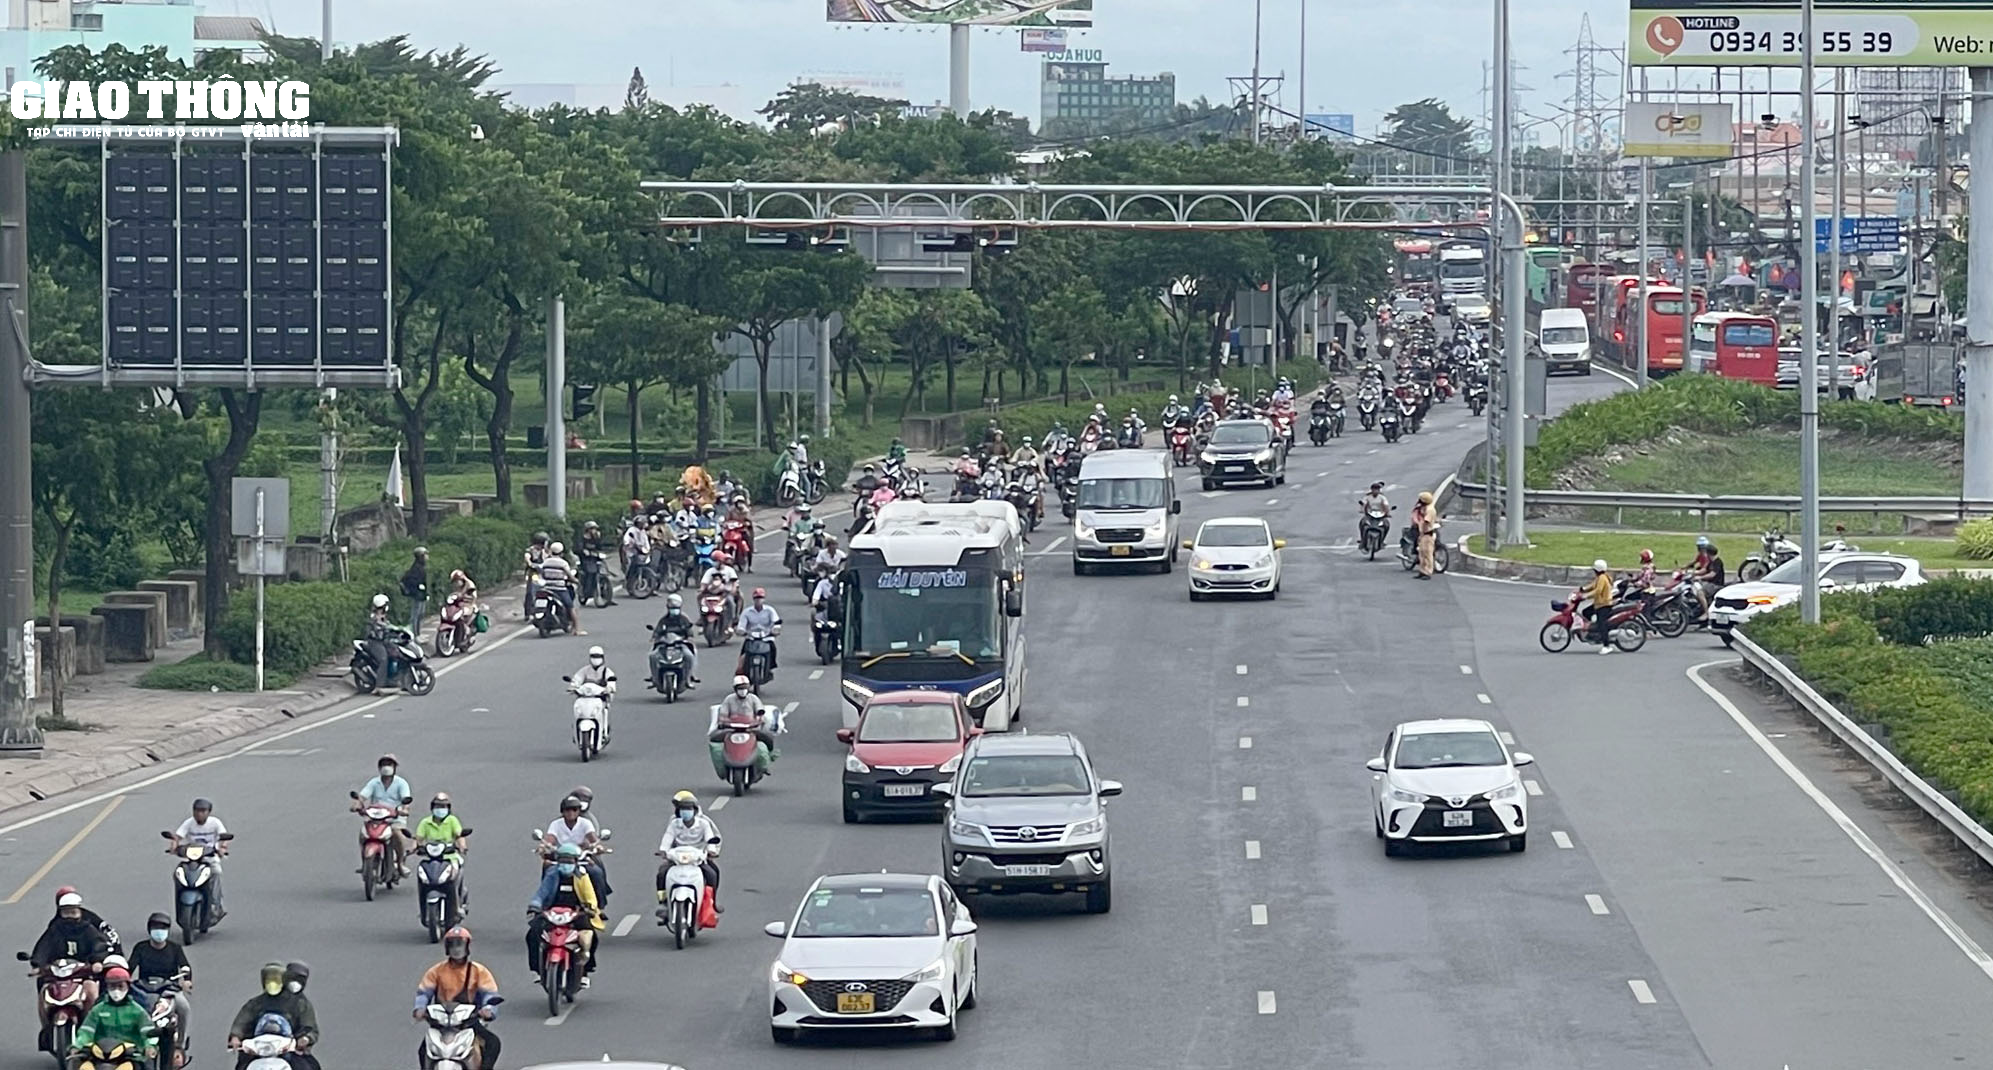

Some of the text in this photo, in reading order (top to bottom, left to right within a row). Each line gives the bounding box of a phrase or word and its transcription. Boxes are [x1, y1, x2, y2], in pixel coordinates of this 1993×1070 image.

[1686, 18, 1735, 29] HOTLINE
[1710, 31, 1772, 52] 0934
[1822, 31, 1851, 52] 55
[1862, 32, 1892, 52] 39
[1934, 35, 1984, 53] Web:
[910, 568, 966, 587] DUYÊN
